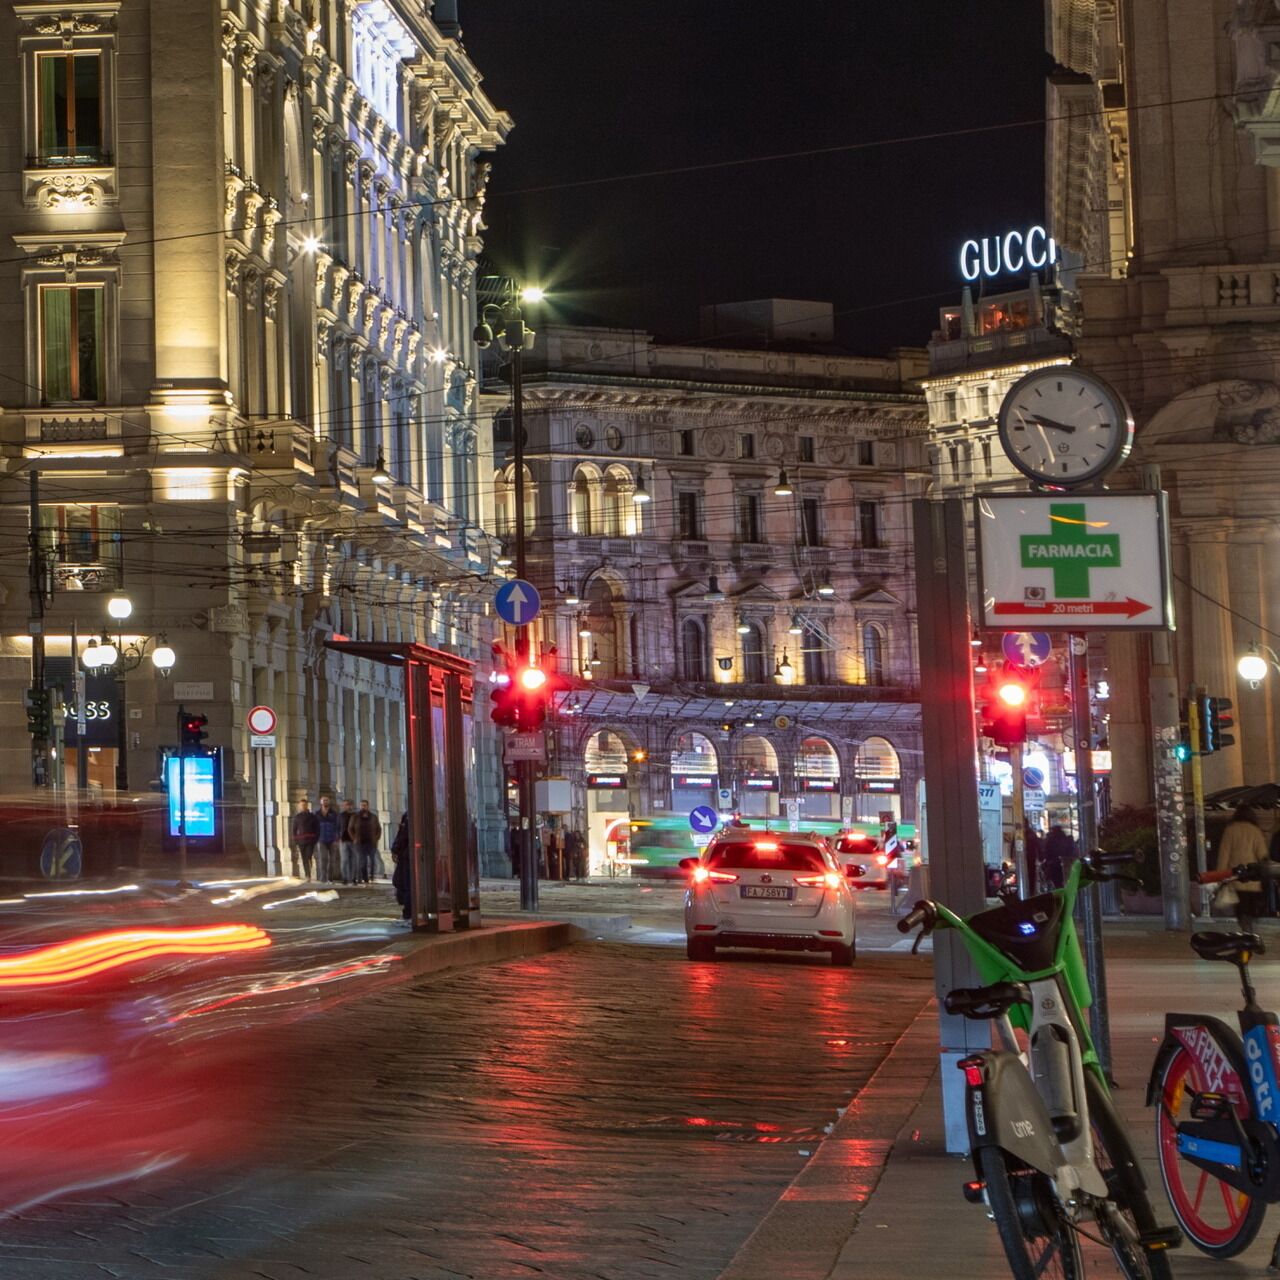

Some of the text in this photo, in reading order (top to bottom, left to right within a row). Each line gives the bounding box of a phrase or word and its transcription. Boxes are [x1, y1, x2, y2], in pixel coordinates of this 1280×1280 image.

[960, 225, 1057, 281] GUCCI
[1028, 544, 1114, 558] FARMACIA
[1052, 603, 1066, 613] 20
[1067, 603, 1094, 613] metri
[514, 737, 536, 748] TRAM
[1246, 1037, 1273, 1117] dott
